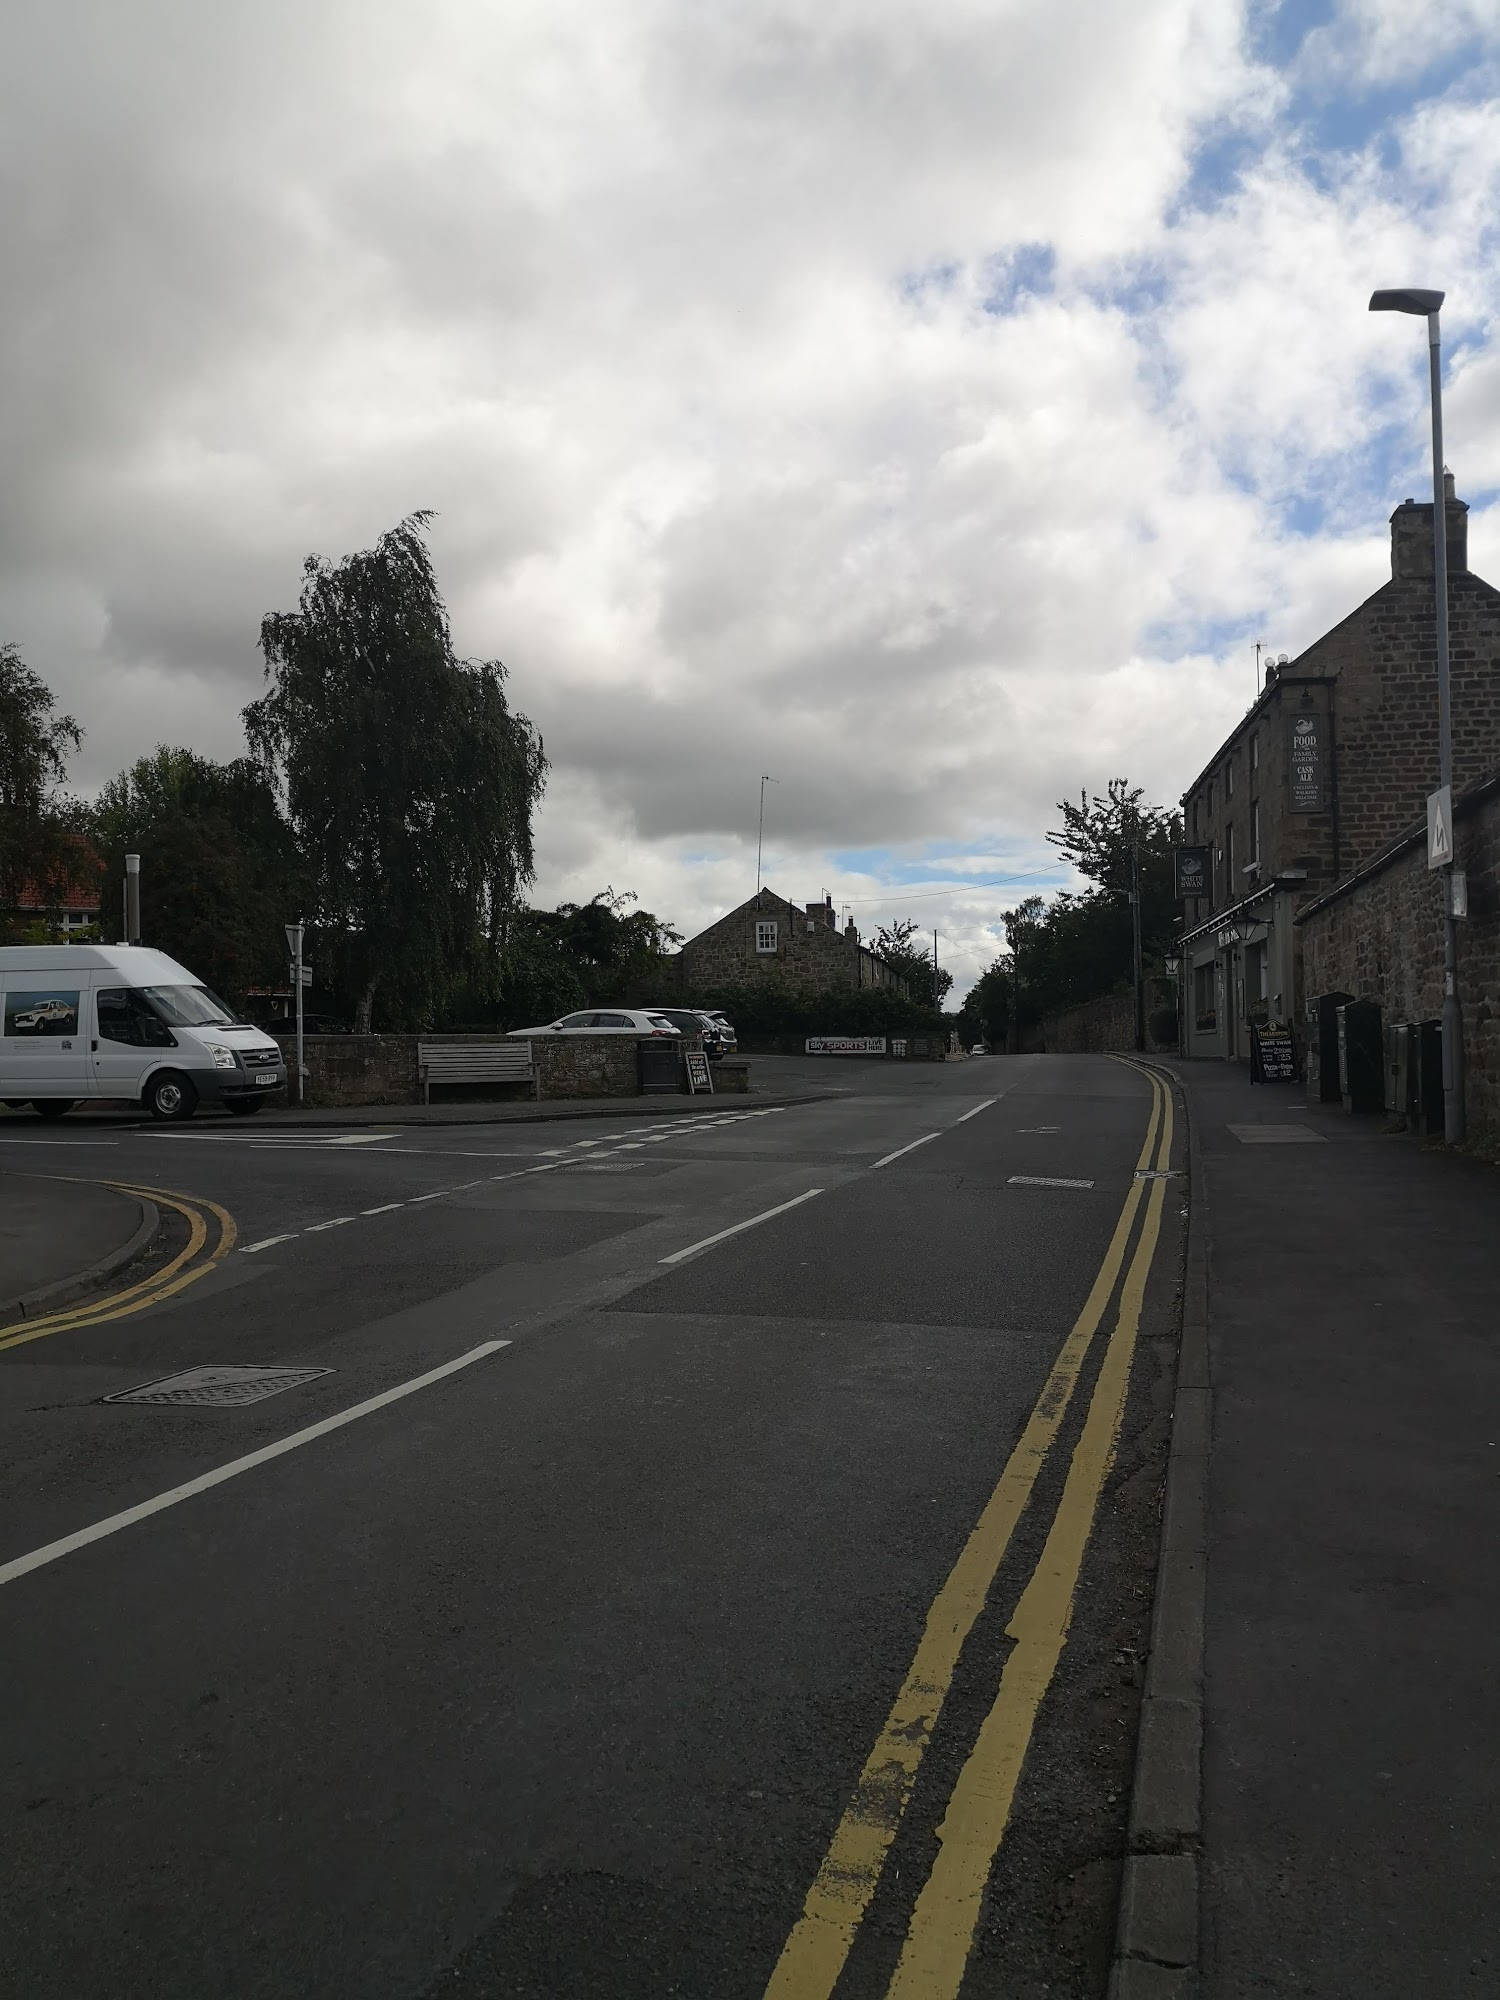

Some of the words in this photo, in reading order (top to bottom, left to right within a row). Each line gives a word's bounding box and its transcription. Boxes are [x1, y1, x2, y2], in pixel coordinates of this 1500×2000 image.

[1293, 735, 1317, 748] FOOD
[1297, 765, 1314, 774] CASK
[1299, 773, 1313, 782] ALE
[810, 1041, 824, 1053] sky
[826, 1041, 866, 1050] SPORTS
[693, 1074, 708, 1085] LIVE
